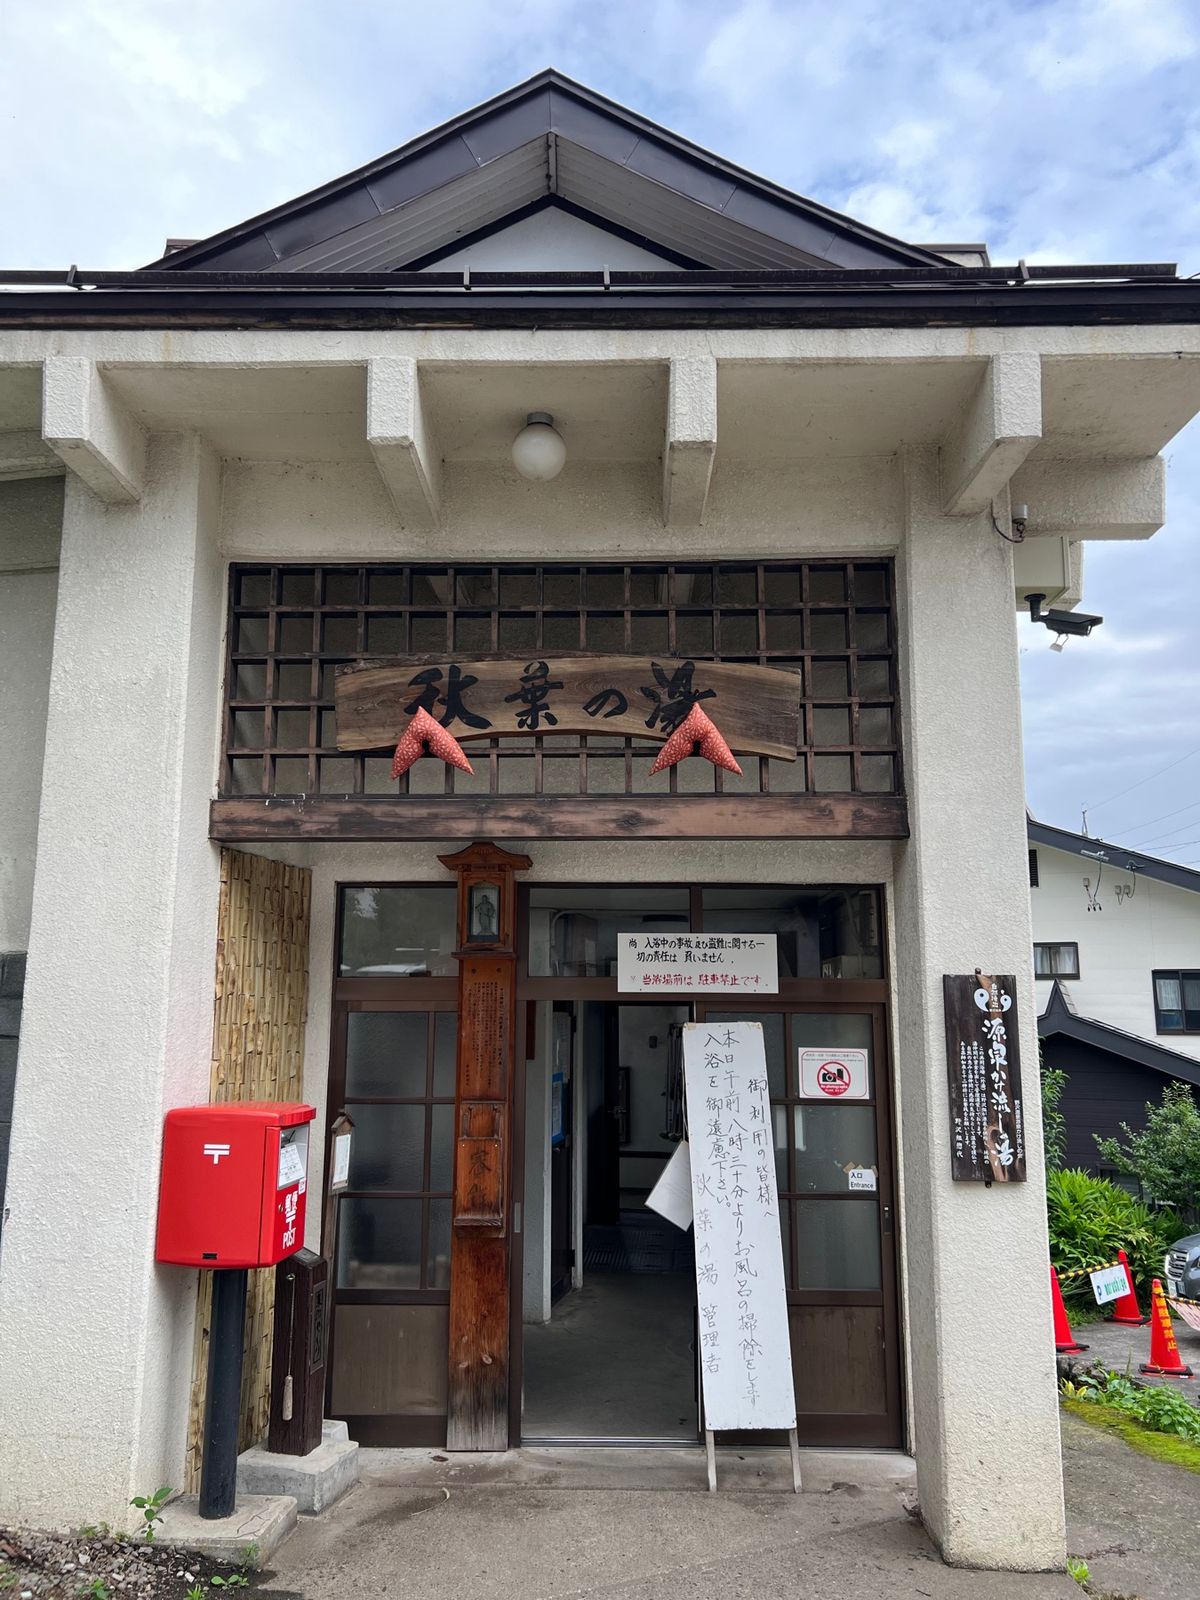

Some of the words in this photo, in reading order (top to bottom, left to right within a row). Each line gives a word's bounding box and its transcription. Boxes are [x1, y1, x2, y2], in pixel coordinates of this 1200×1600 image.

[404, 660, 717, 737] 秋葉の湯
[636, 951, 678, 963] 切の責任は
[642, 973, 694, 986] 当浴場前は
[982, 1017, 1014, 1166] 源泉かけ流しの湯
[747, 1078, 776, 1217] 御利用の皆様へ
[850, 1172, 863, 1180] 入口
[850, 1181, 874, 1190] Entrance
[282, 1228, 297, 1250] POST
